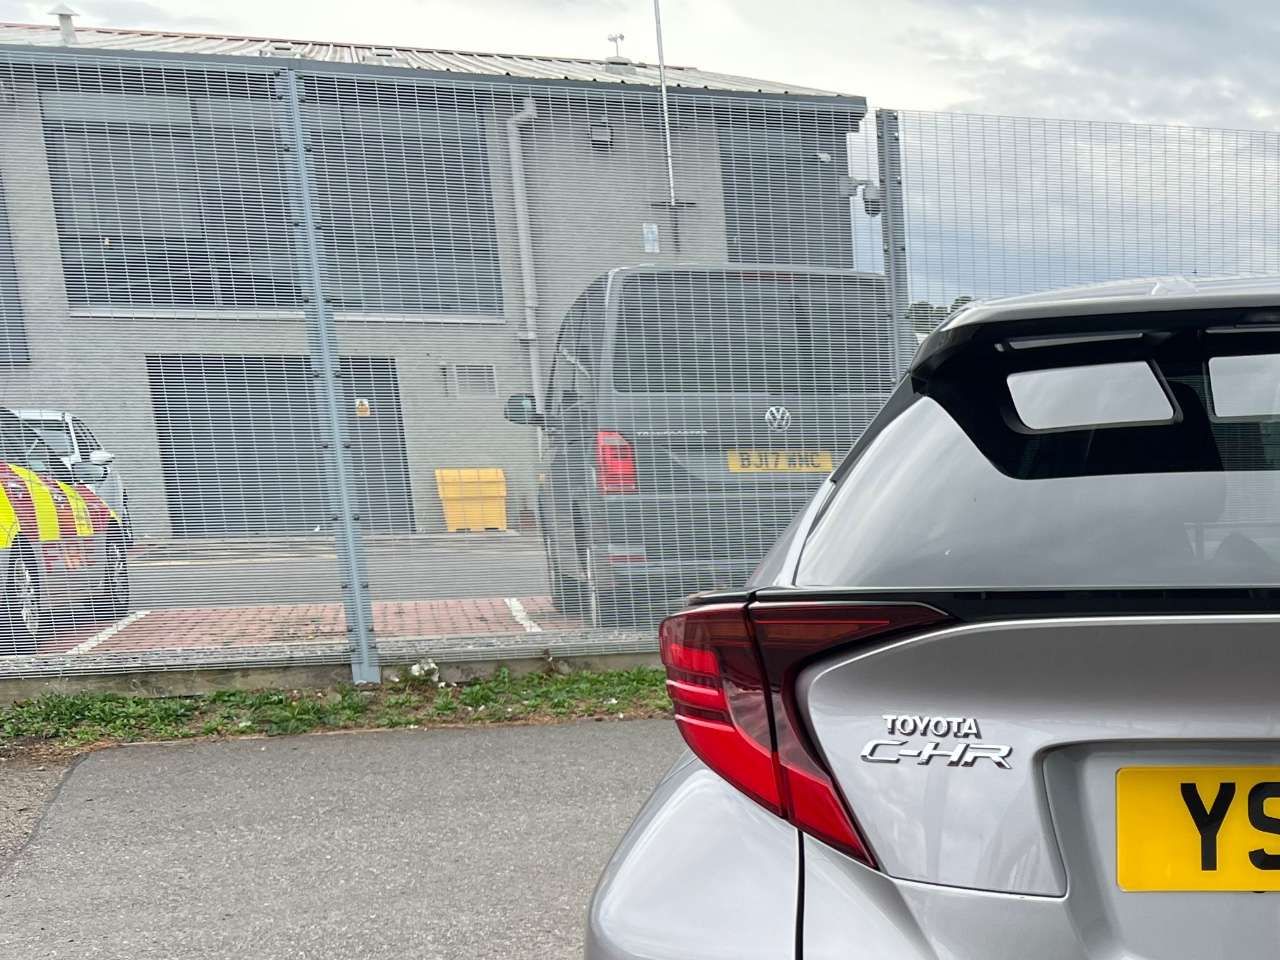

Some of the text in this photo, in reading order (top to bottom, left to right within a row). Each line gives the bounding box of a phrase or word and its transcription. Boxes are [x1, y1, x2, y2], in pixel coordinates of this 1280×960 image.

[42, 538, 96, 574] FRE
[882, 715, 982, 739] TOYOTA
[861, 740, 1013, 769] C-HR
